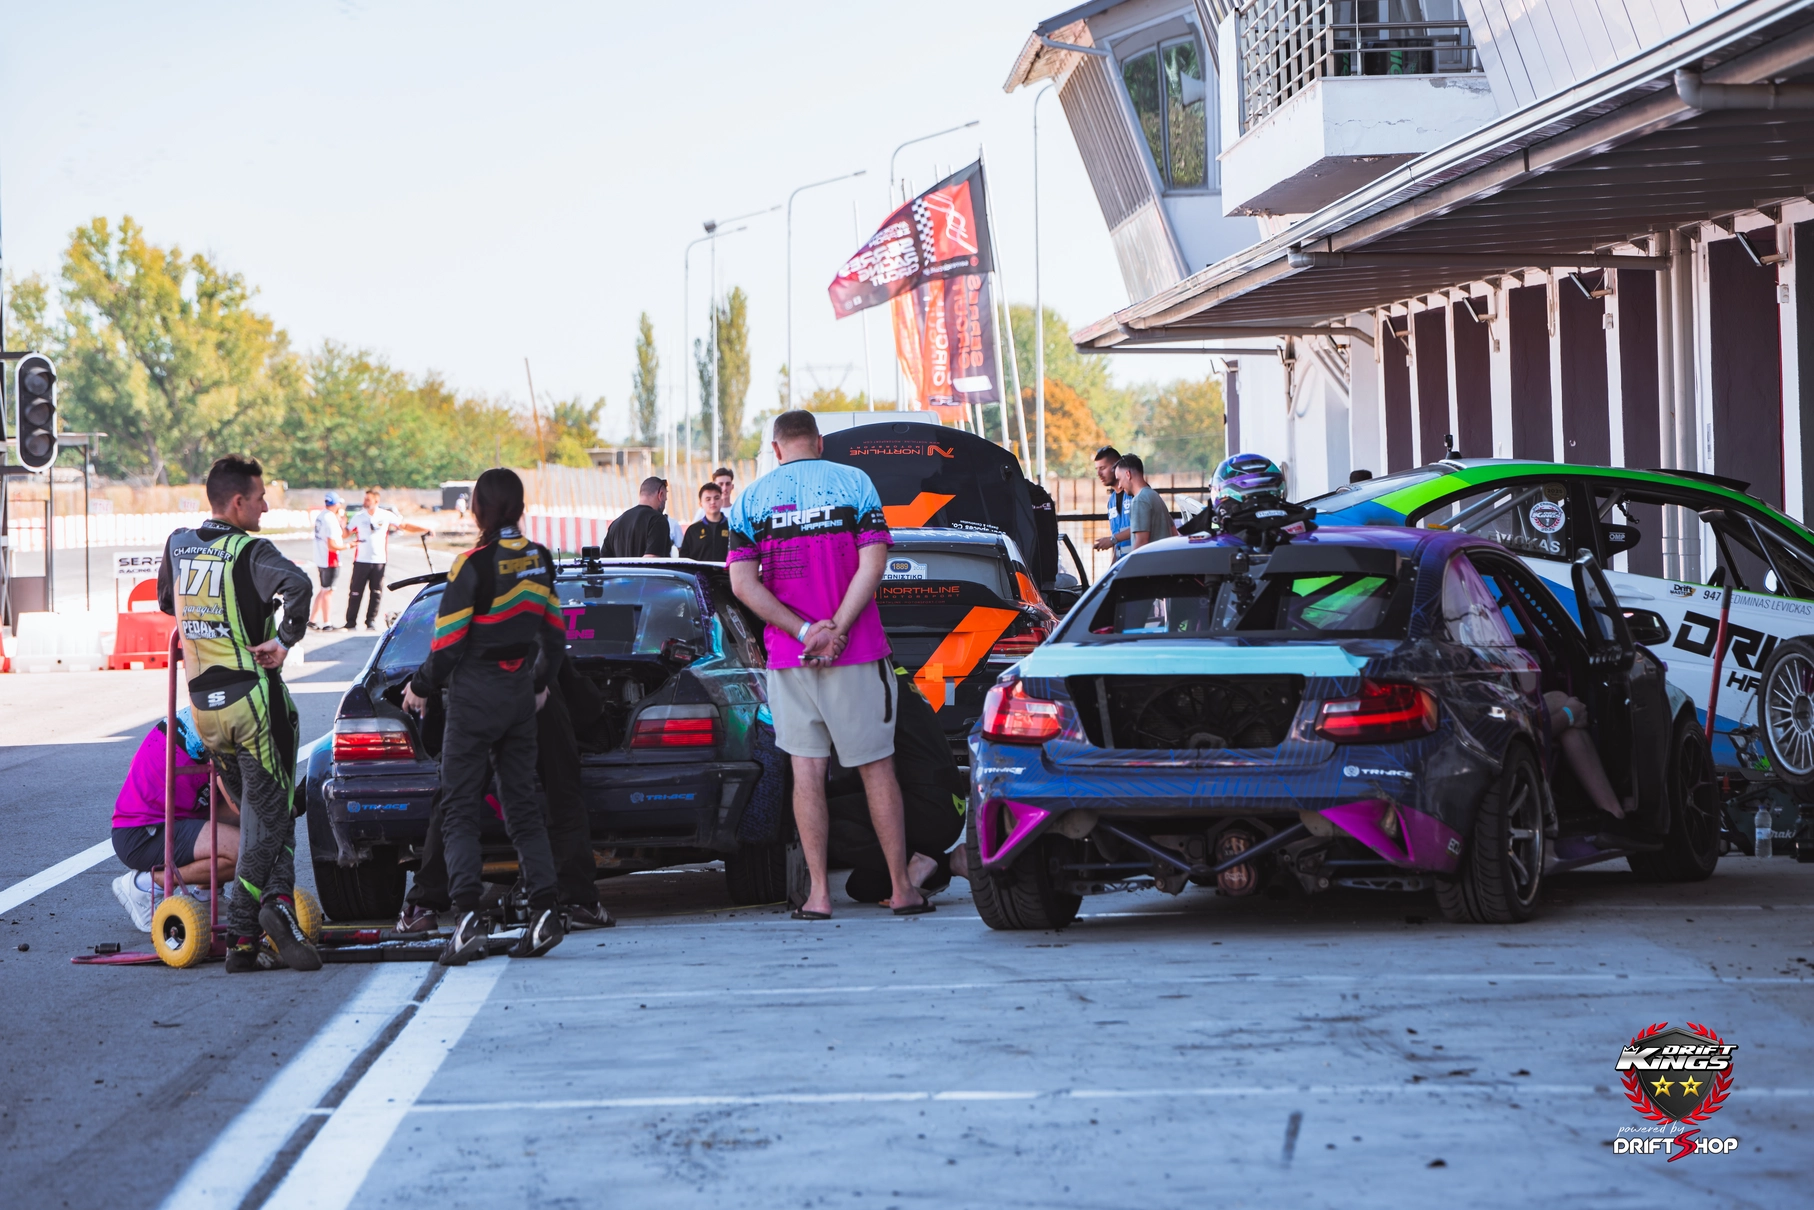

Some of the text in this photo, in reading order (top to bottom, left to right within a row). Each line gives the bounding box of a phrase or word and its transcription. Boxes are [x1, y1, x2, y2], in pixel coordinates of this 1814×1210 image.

[771, 505, 836, 529] DRIFT
[800, 519, 843, 531] HAPPENS
[173, 546, 232, 560] CHARPENTIER
[119, 556, 163, 567] SERR
[179, 559, 225, 597] 171
[883, 586, 960, 595] NORTHLINE
[1674, 584, 1693, 593] Drift
[1703, 590, 1813, 616] 947 EDIMINAS LEVICKAS
[182, 620, 215, 634] PEDAL
[1672, 610, 1786, 674] DRI
